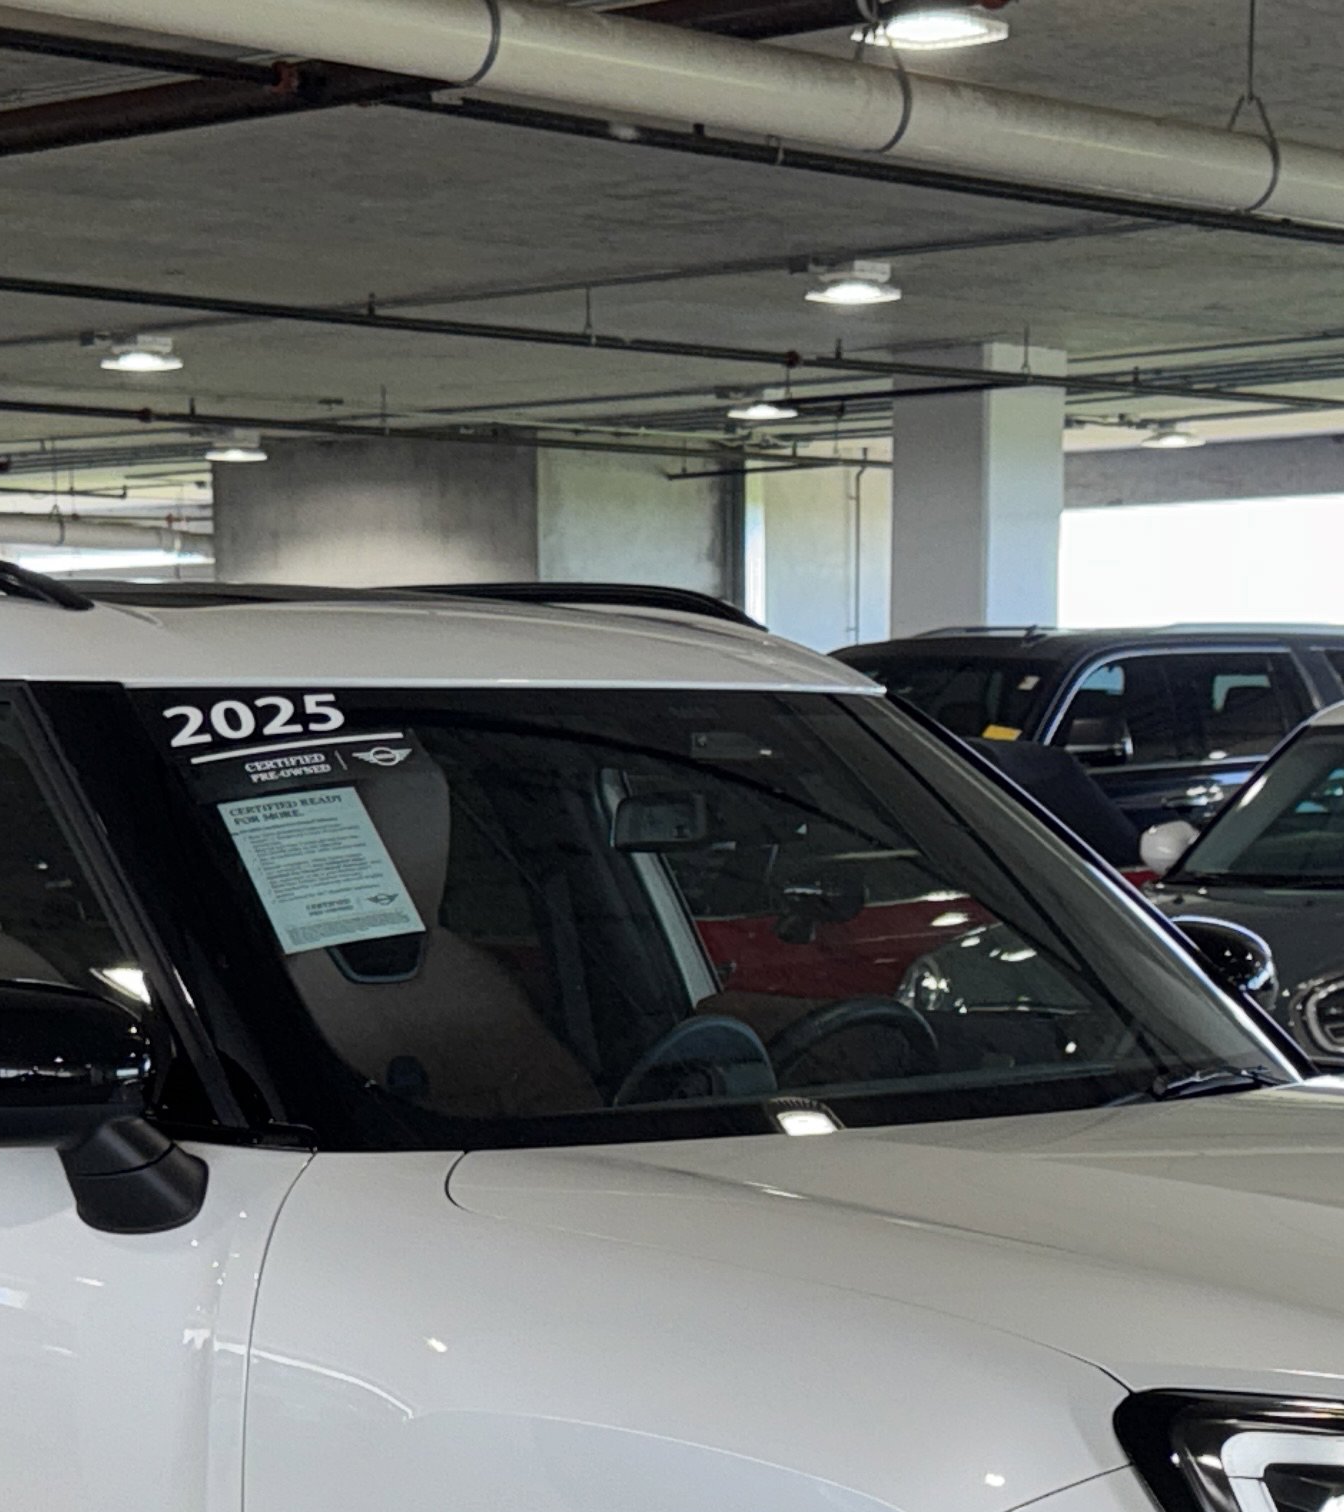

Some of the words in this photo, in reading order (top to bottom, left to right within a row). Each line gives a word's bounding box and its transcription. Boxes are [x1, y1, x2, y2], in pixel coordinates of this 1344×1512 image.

[162, 693, 345, 748] 2025
[244, 753, 326, 773] CERTIFIED
[249, 764, 331, 783] PRE-OWNED
[229, 800, 299, 817] CERTIFIED
[233, 814, 261, 826] FOR
